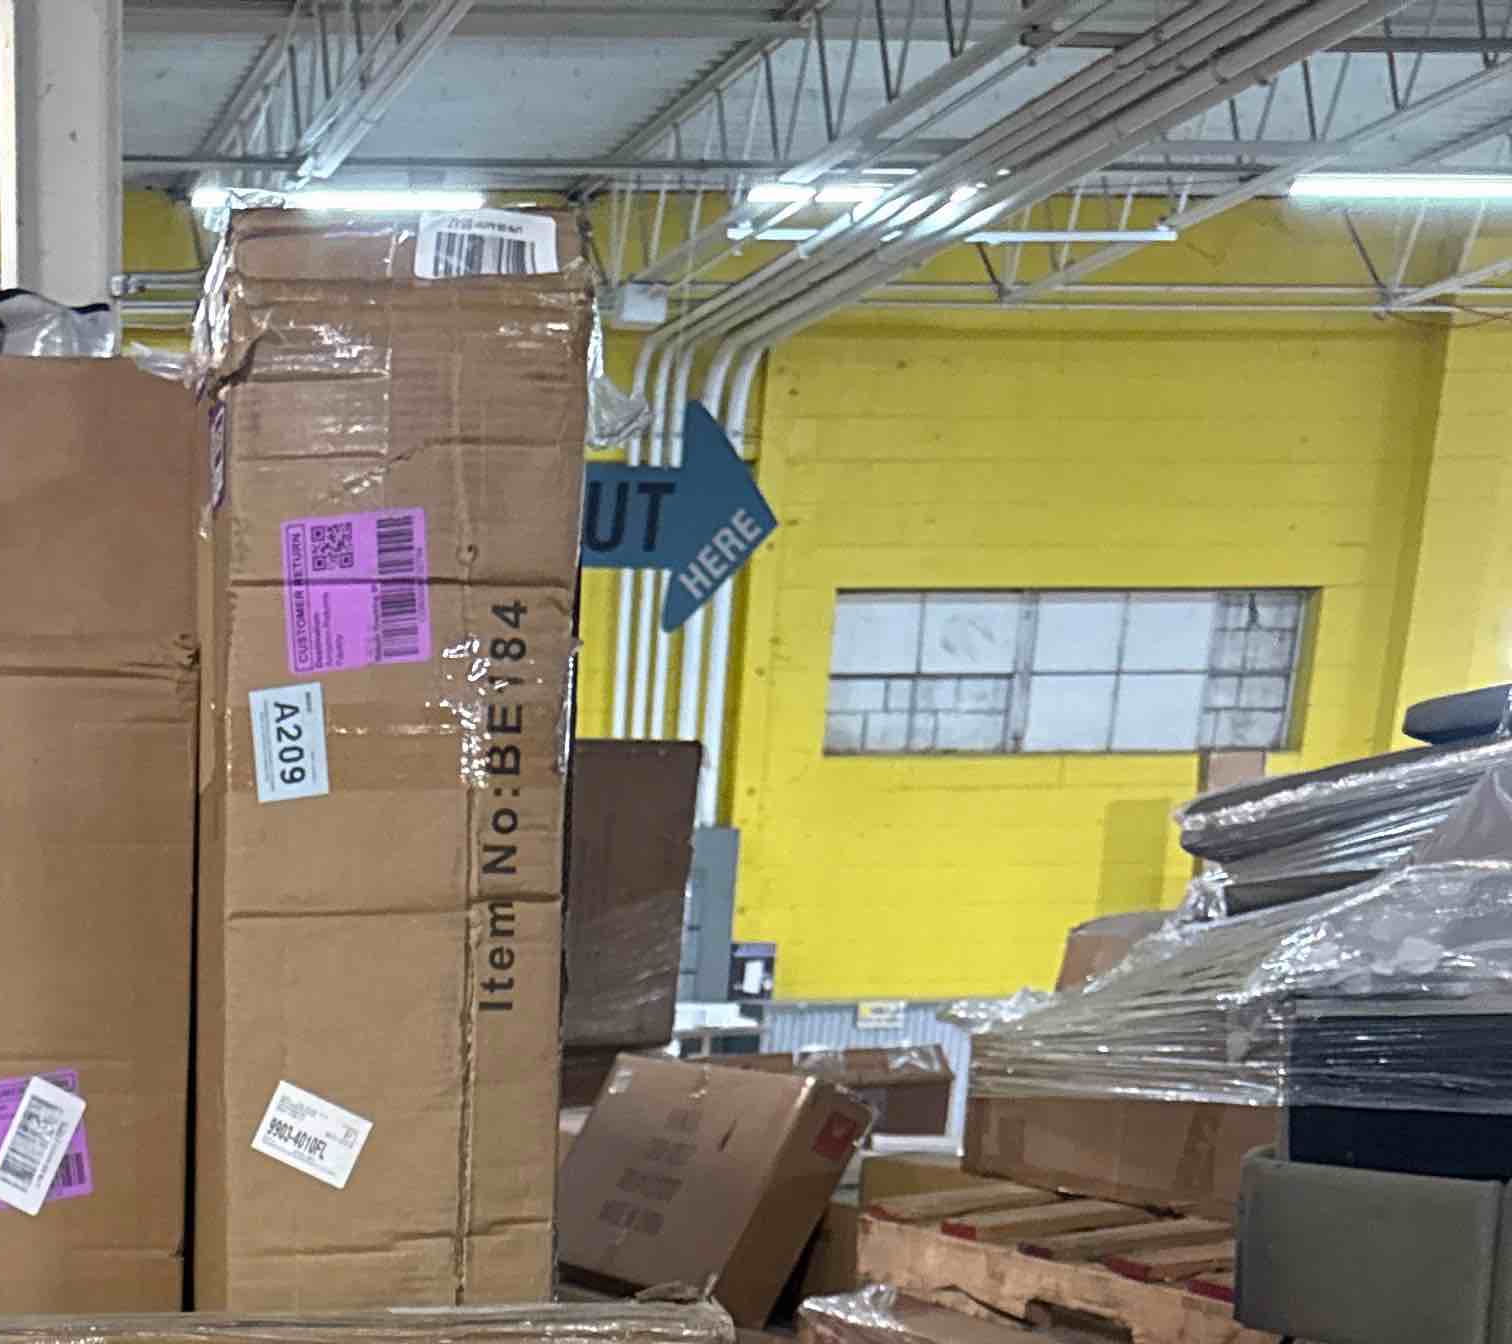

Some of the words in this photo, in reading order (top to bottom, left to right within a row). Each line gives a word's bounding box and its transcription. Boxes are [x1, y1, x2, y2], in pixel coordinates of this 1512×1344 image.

[291, 532, 304, 586] RETURN
[679, 508, 762, 600] HERE
[294, 590, 309, 664] CUSTOMER
[274, 701, 306, 785] A209
[478, 901, 514, 1012] Item
